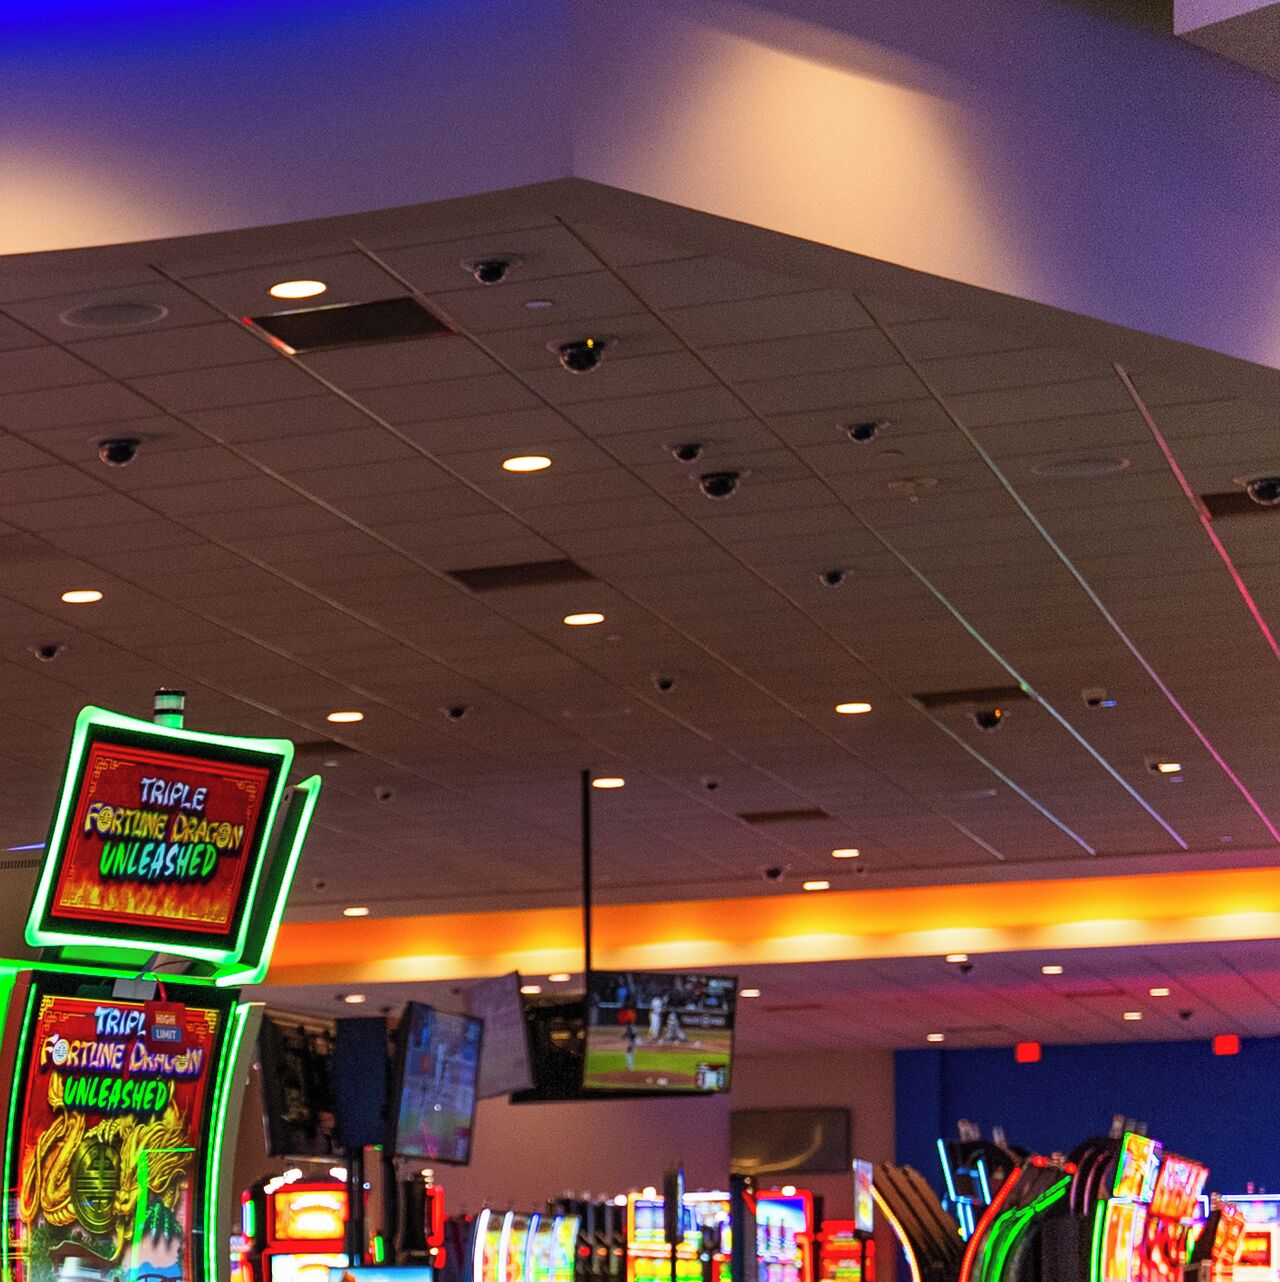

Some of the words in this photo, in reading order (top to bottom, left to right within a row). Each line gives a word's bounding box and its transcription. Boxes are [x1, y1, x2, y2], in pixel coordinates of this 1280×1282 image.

[139, 777, 207, 812] TRIPLE
[83, 801, 168, 840] FORTUNE
[170, 811, 244, 850] DRAGON
[99, 840, 218, 880] UNLEASHED
[94, 1006, 147, 1036] TRIPL
[155, 1013, 177, 1026] HIGH
[156, 1028, 178, 1040] LIMIT
[40, 1033, 126, 1070] FORTUNE
[63, 1075, 169, 1111] UNLEASHED
